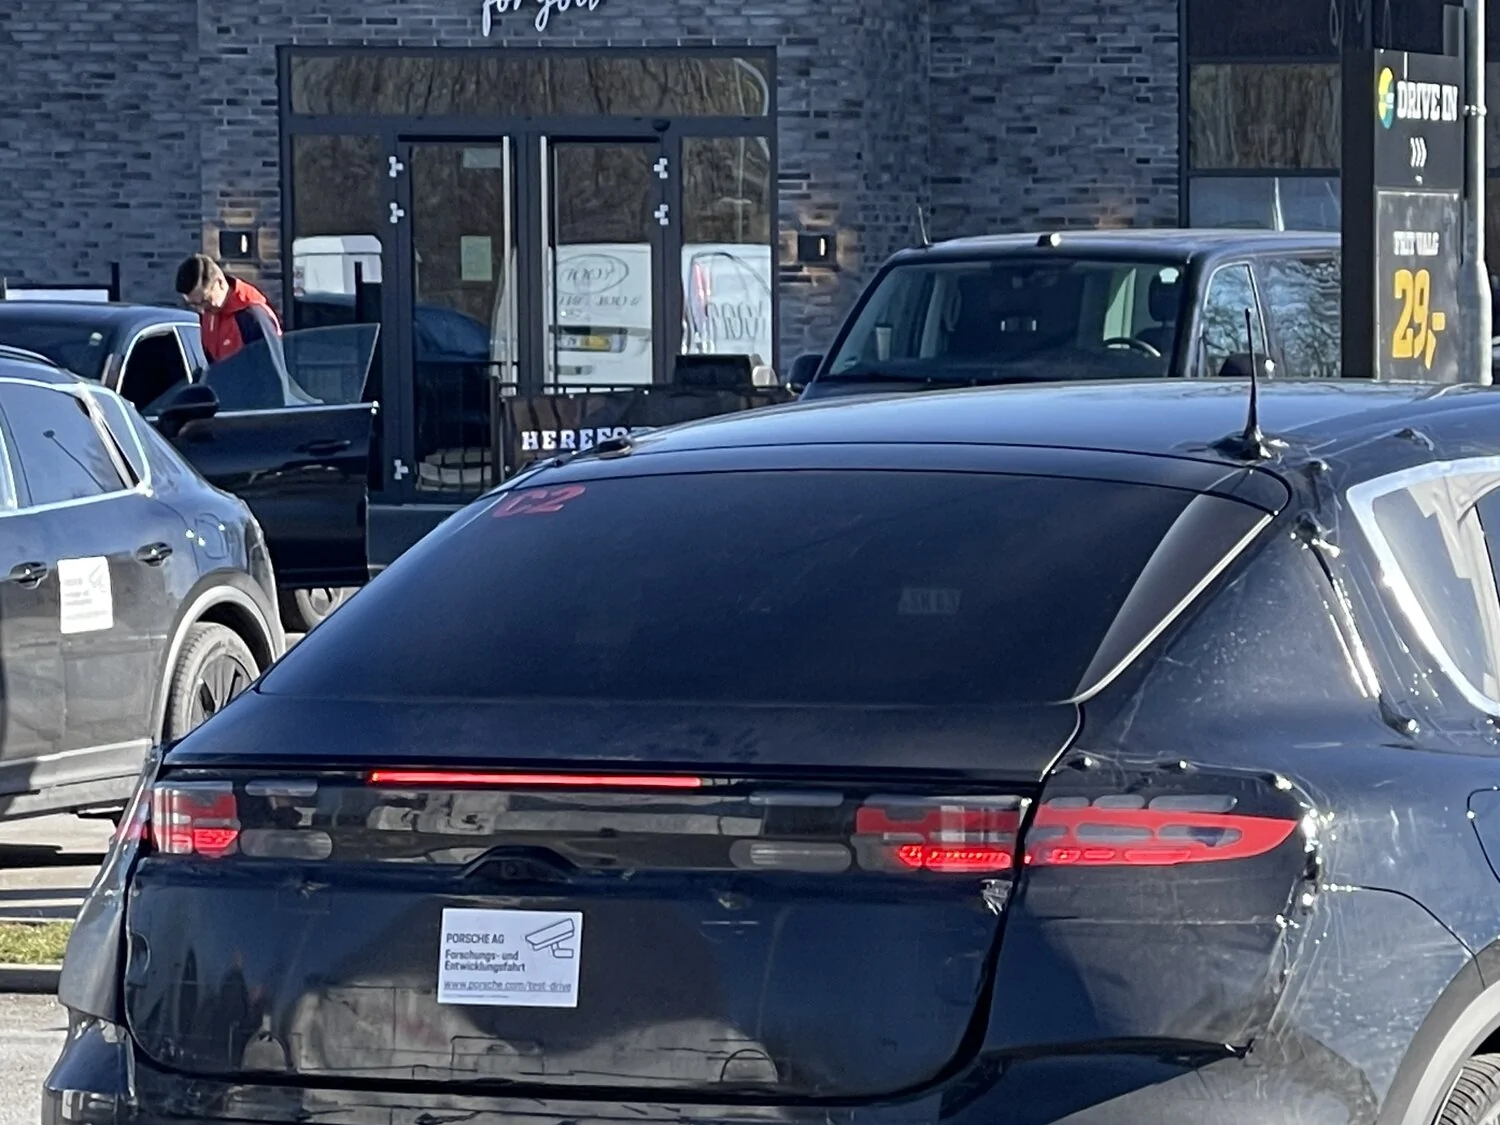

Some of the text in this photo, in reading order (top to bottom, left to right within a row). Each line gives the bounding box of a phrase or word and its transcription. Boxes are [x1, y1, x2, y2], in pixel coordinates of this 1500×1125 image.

[1397, 81, 1440, 120] DRIVE
[1441, 84, 1458, 121] IN
[492, 484, 586, 518] C2
[446, 933, 505, 944] PORSCHE AG
[445, 949, 519, 962] Forschungs- und
[444, 961, 525, 973] Entwicklungsfahrt
